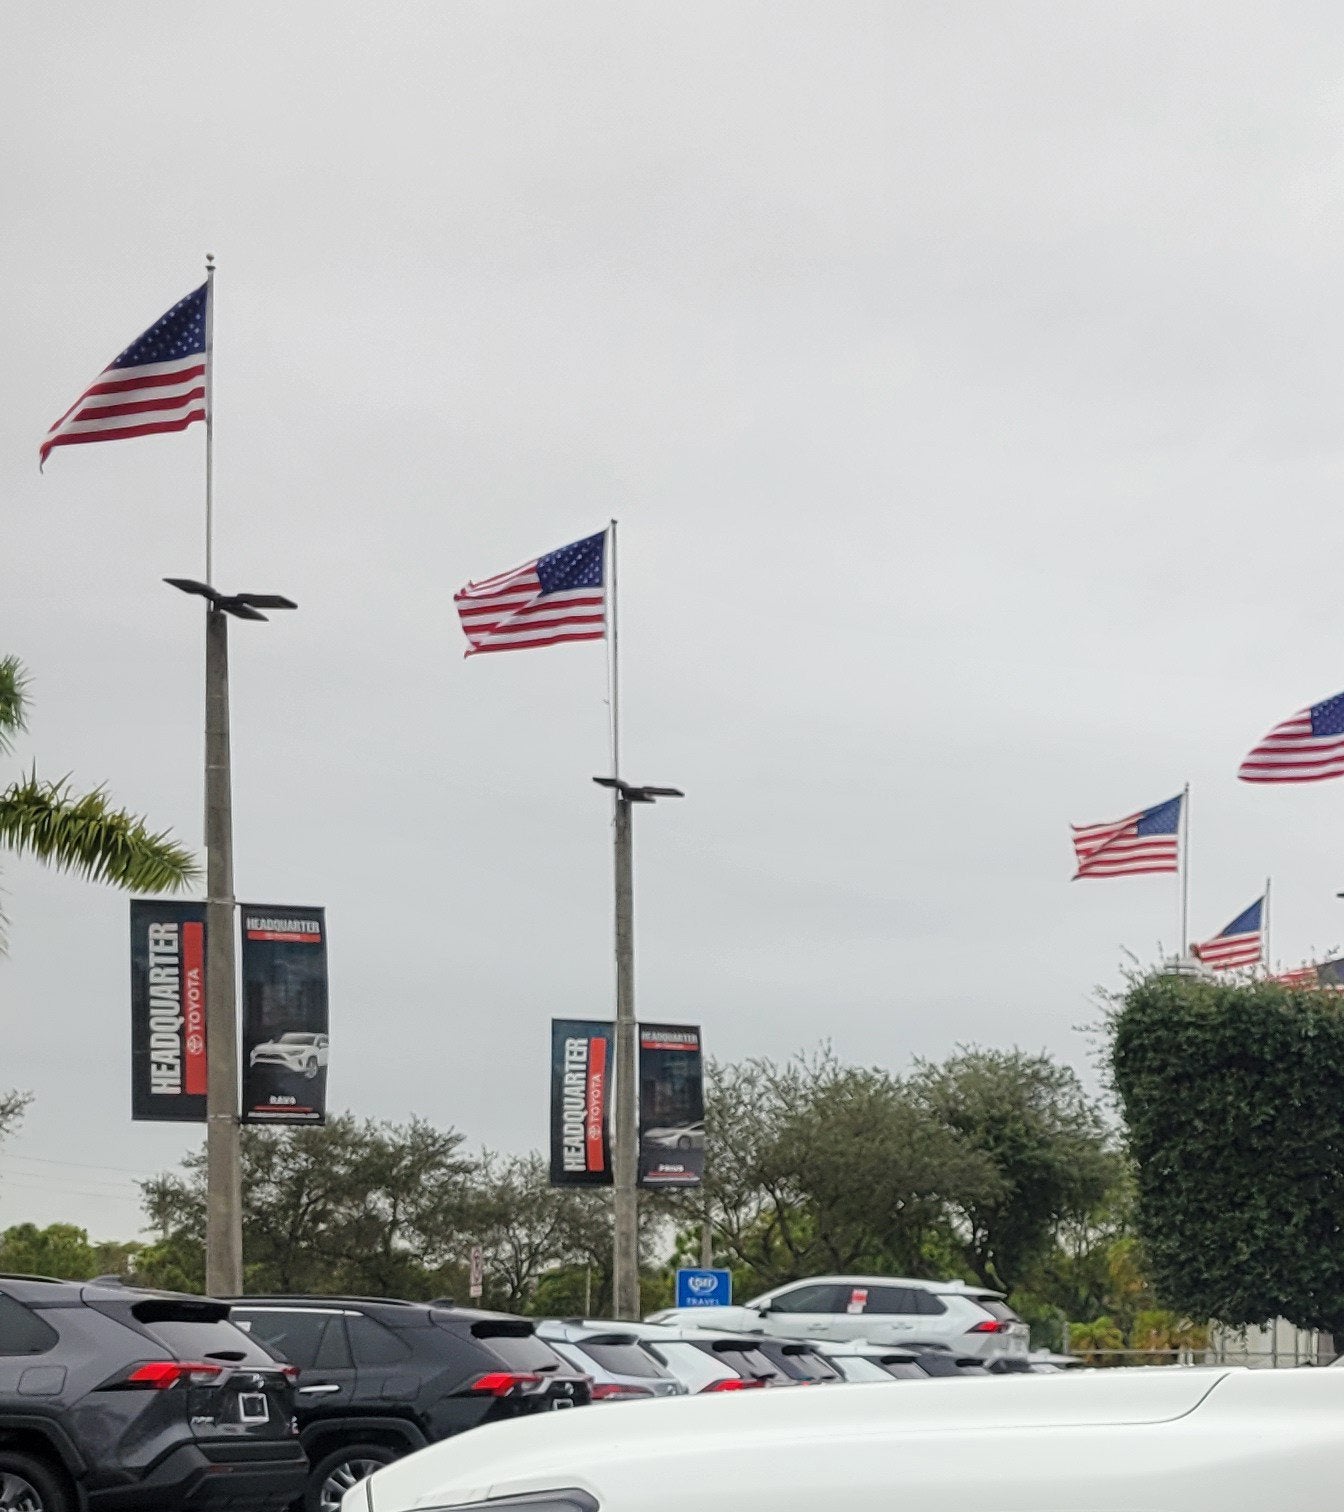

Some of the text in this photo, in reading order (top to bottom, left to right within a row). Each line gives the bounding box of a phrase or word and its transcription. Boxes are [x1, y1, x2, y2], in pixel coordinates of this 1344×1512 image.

[246, 917, 320, 933] HEADQUARTER
[149, 922, 184, 1095] HEADQUARTER
[187, 968, 201, 1031] TOYOTA
[562, 1037, 588, 1172] HEADQUARTER
[589, 1074, 602, 1118] TOYOTA
